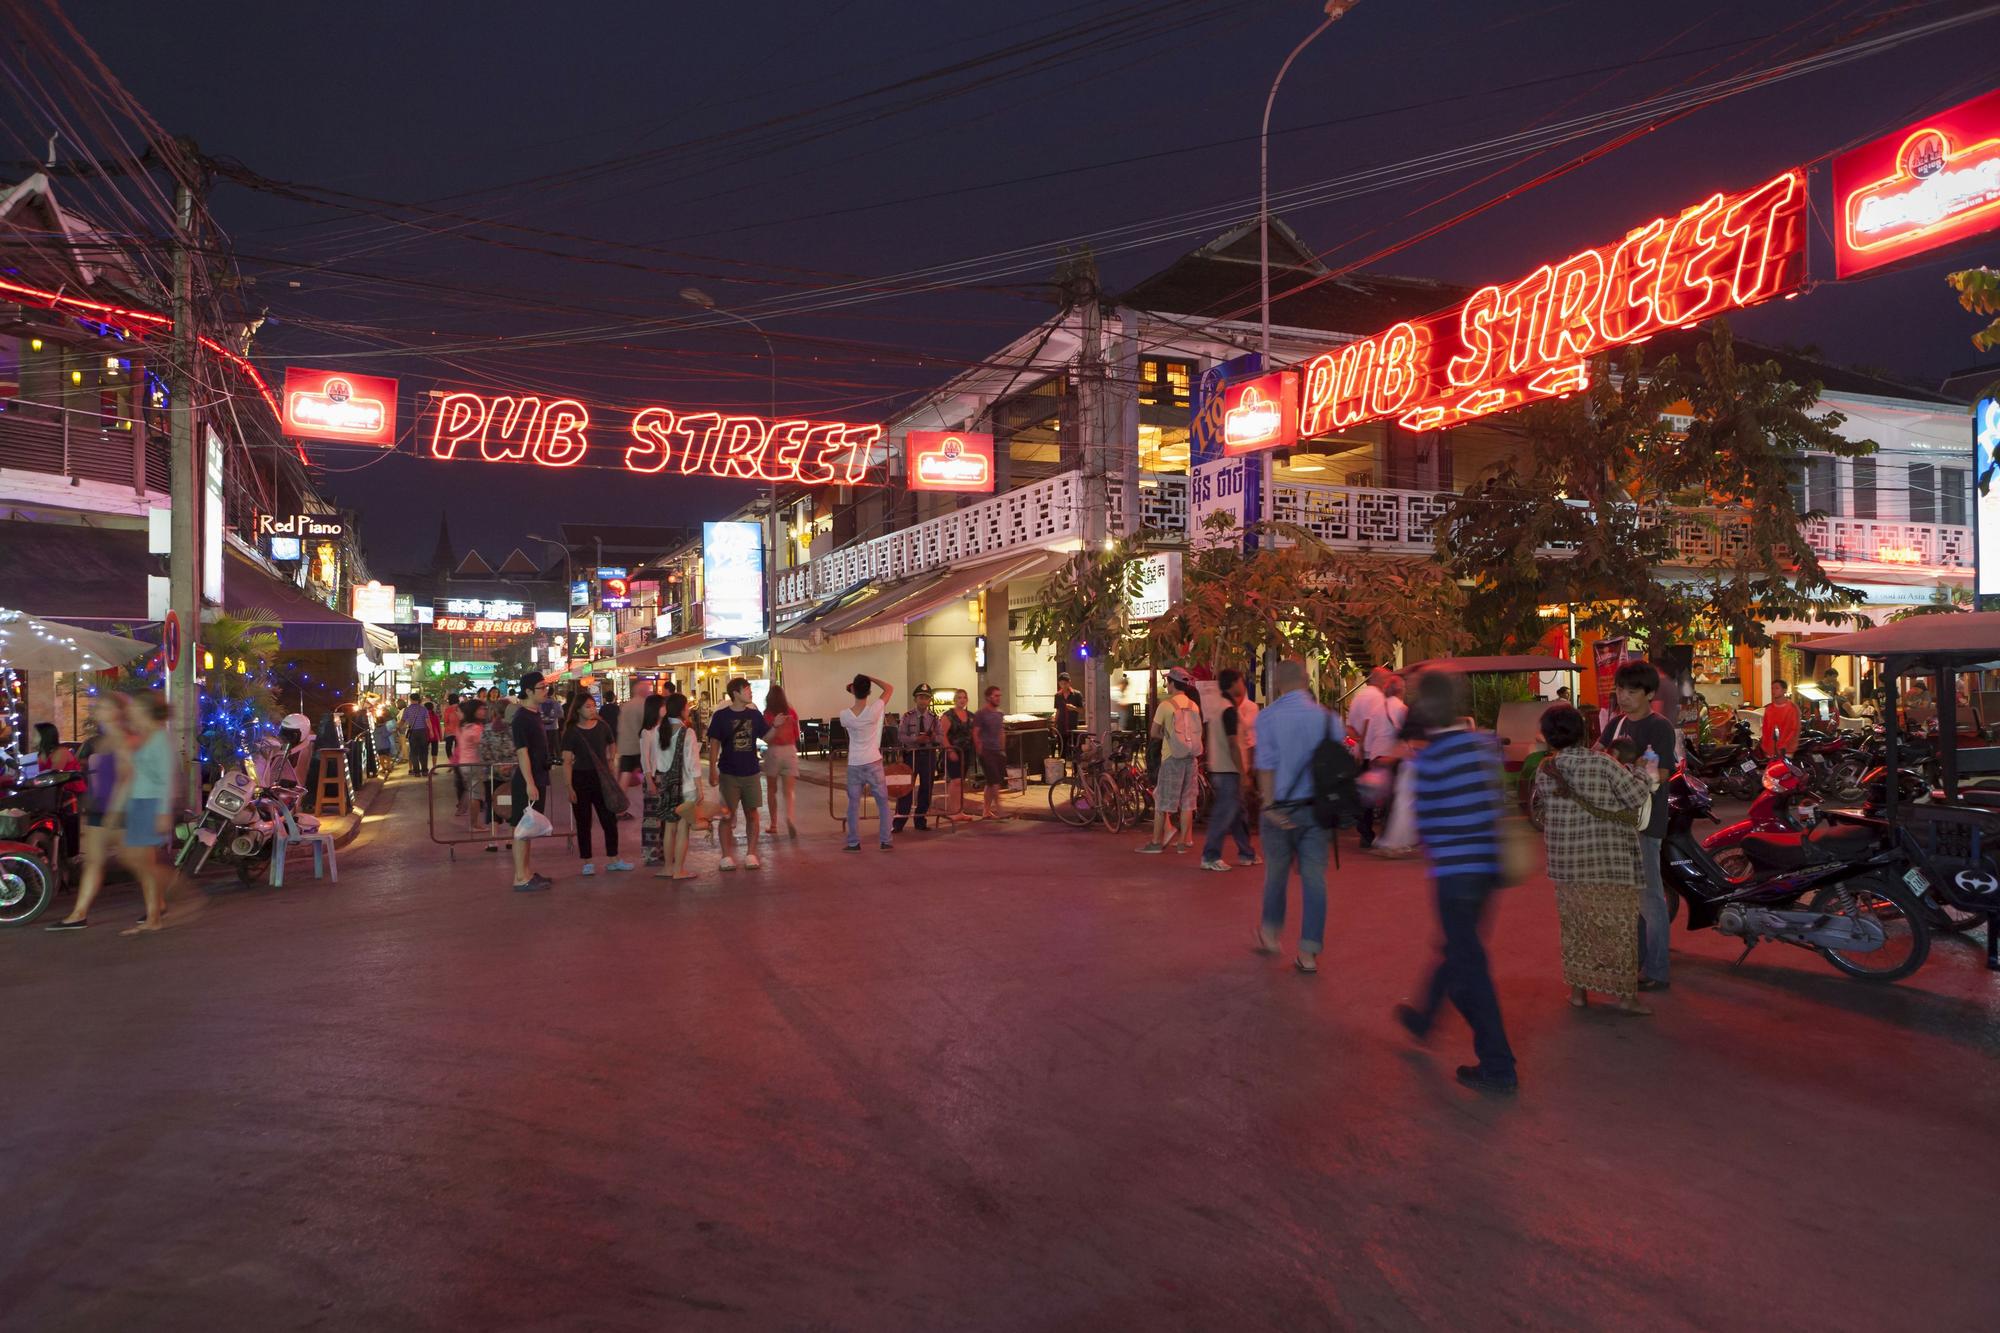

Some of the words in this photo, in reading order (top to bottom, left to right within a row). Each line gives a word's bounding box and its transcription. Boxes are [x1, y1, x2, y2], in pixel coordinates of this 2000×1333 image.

[1301, 321, 1417, 437] PUB
[1447, 172, 1796, 388] STREET
[432, 392, 590, 467] PUB
[624, 407, 881, 485] STREET
[260, 515, 295, 535] Red
[298, 515, 342, 536] Piano
[1142, 599, 1167, 615] STREET
[436, 618, 468, 631] PUB
[473, 620, 532, 633] STREET
